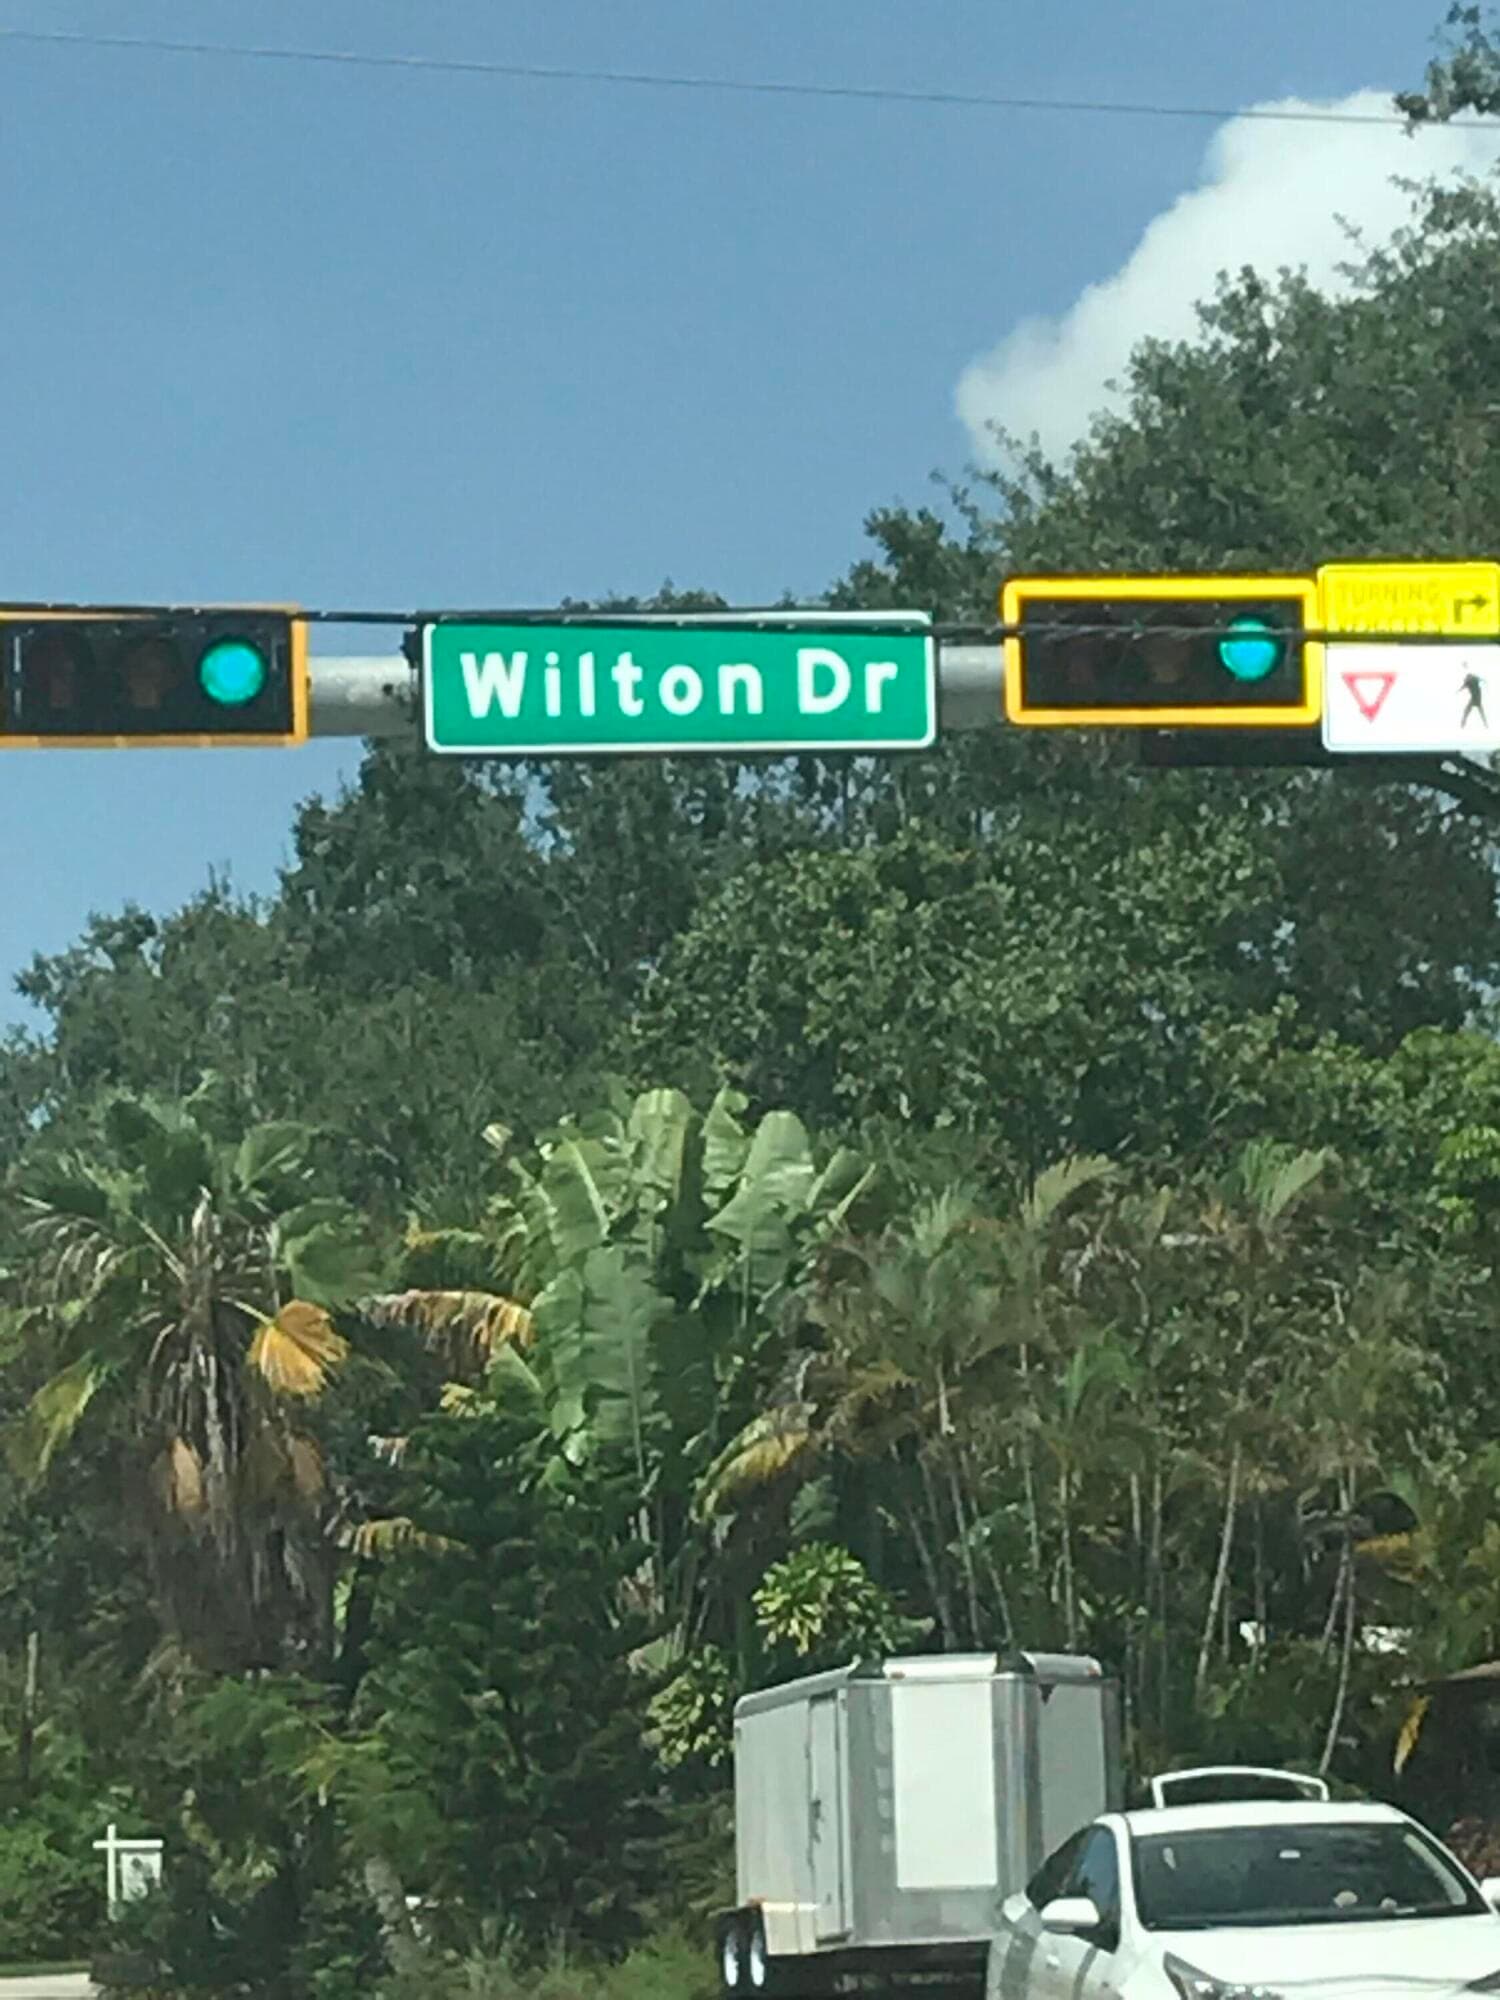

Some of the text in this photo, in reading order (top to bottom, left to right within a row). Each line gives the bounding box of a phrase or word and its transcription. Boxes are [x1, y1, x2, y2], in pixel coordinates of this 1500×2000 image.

[1337, 581, 1440, 605] TURNING
[460, 647, 898, 718] Wilton Dr
